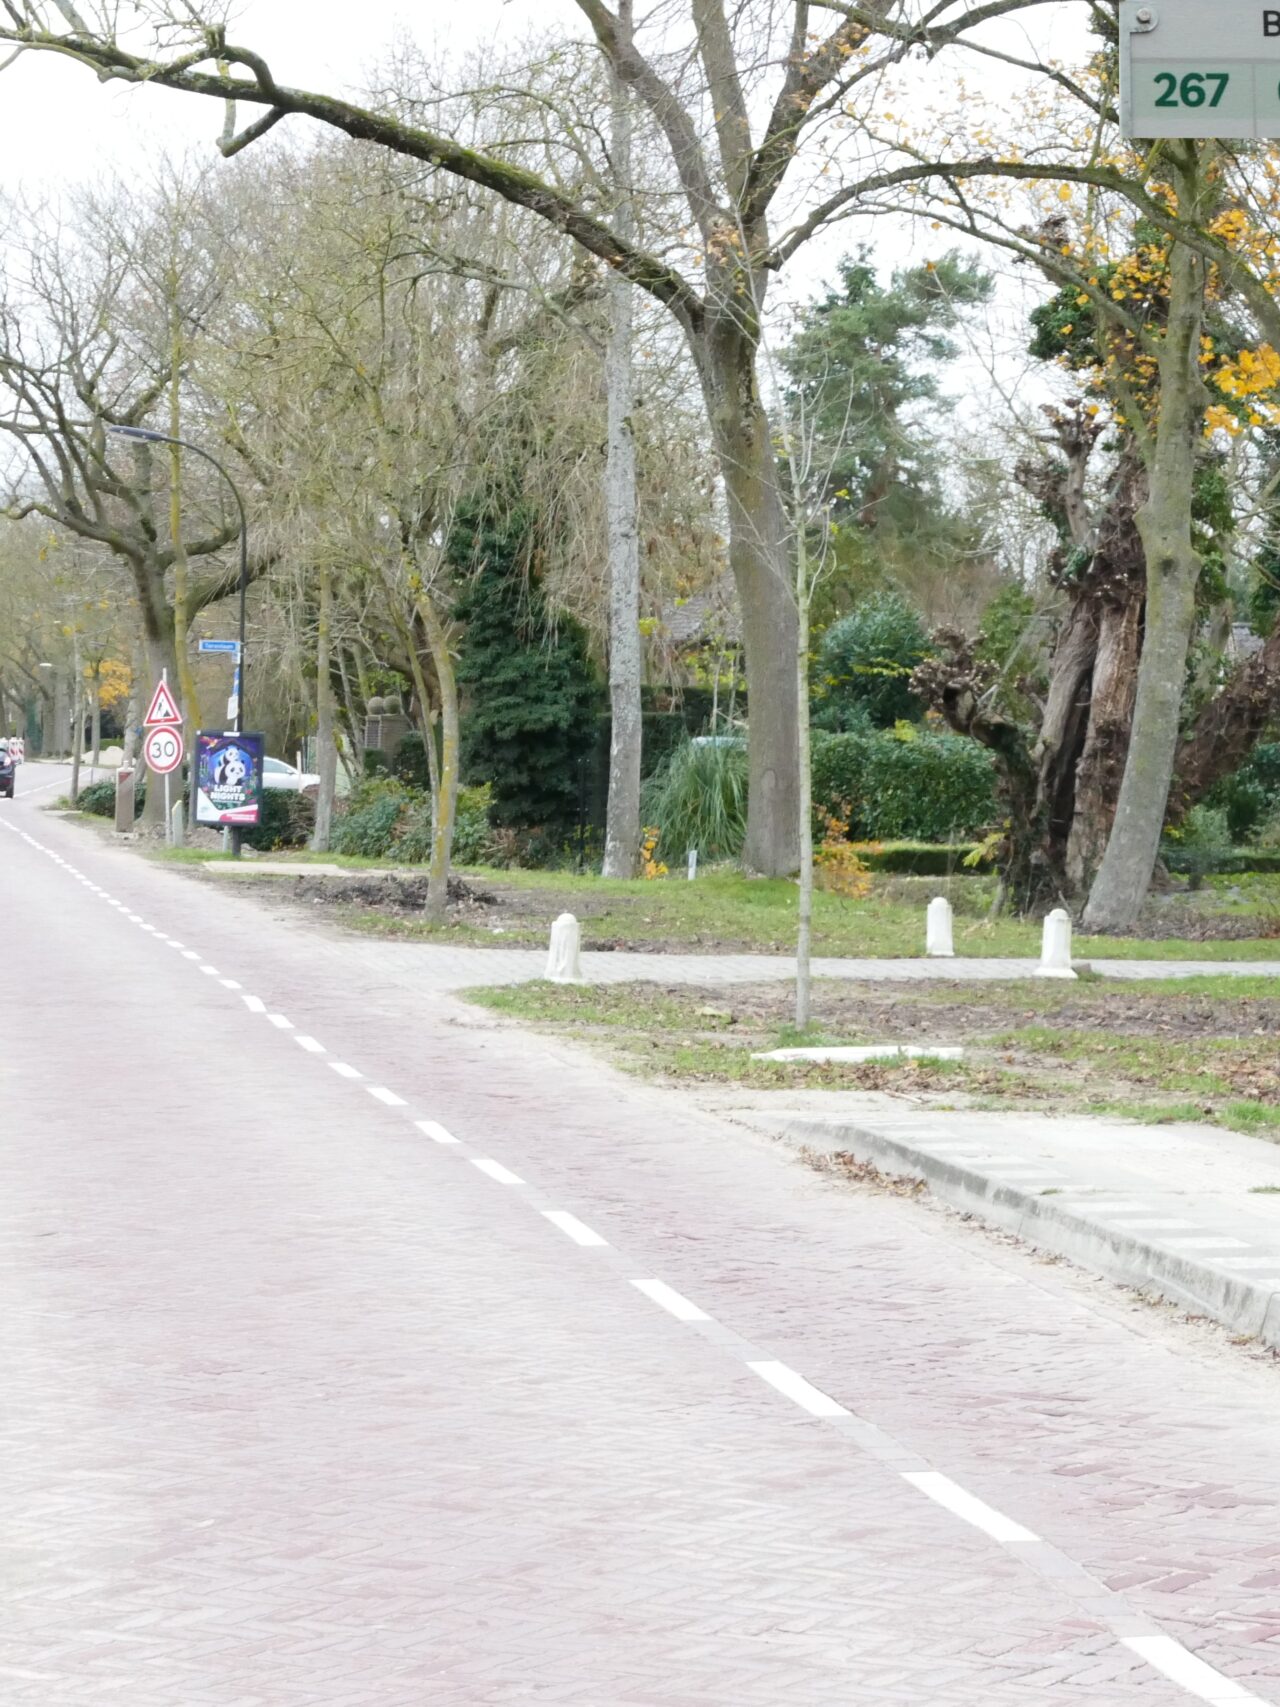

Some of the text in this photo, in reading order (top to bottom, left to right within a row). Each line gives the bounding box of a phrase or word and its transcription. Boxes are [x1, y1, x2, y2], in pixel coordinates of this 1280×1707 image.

[1153, 72, 1230, 108] 267
[151, 741, 175, 758] 30
[213, 784, 242, 793] LIGHT
[210, 791, 246, 801] NIGHTS
